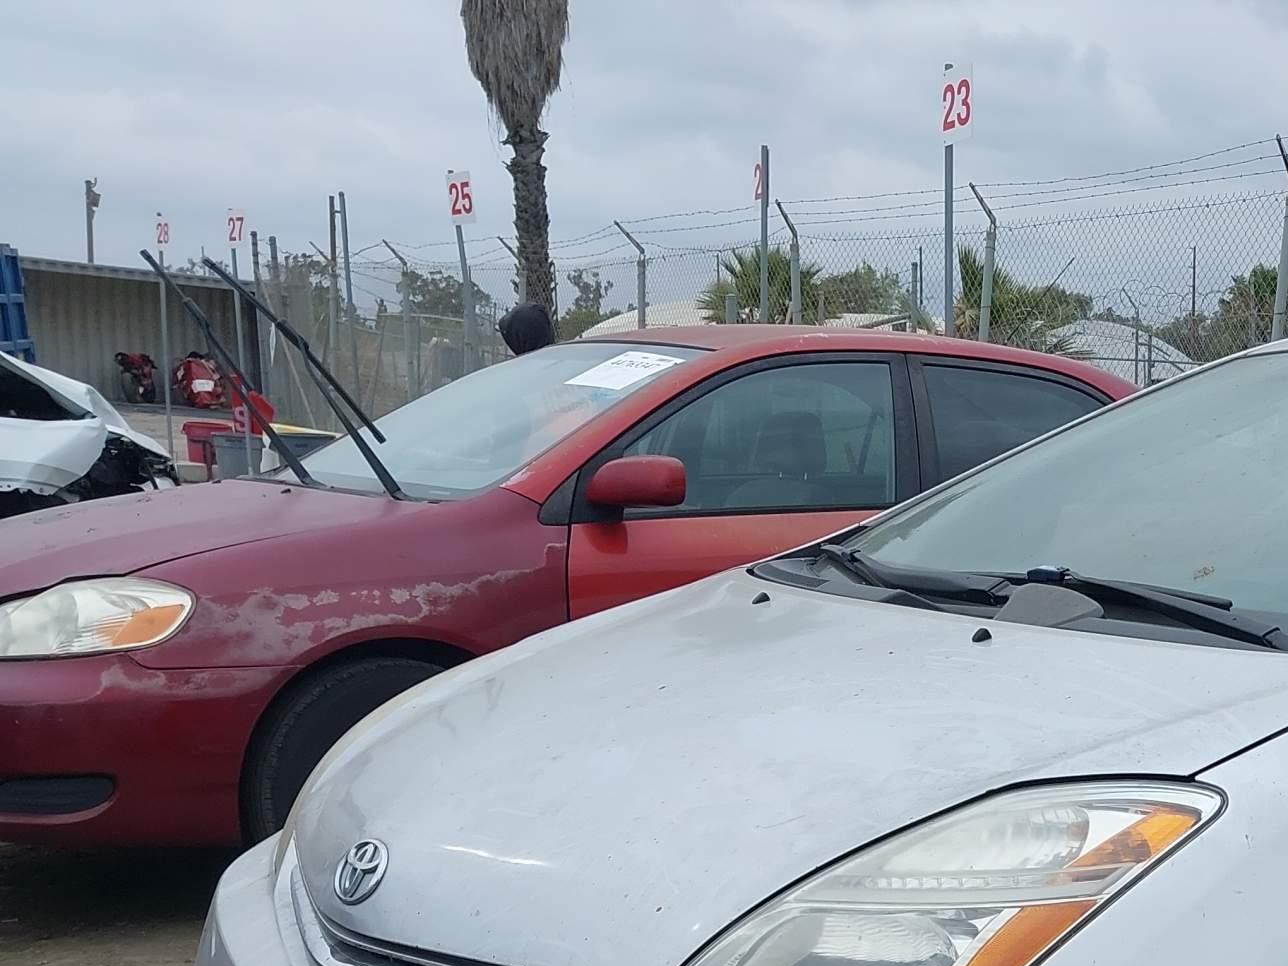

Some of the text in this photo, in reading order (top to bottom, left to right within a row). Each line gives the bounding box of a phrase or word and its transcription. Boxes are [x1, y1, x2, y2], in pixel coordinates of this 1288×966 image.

[943, 79, 971, 132] 23
[448, 181, 473, 216] 25
[156, 222, 169, 244] 28
[227, 216, 244, 242] 27
